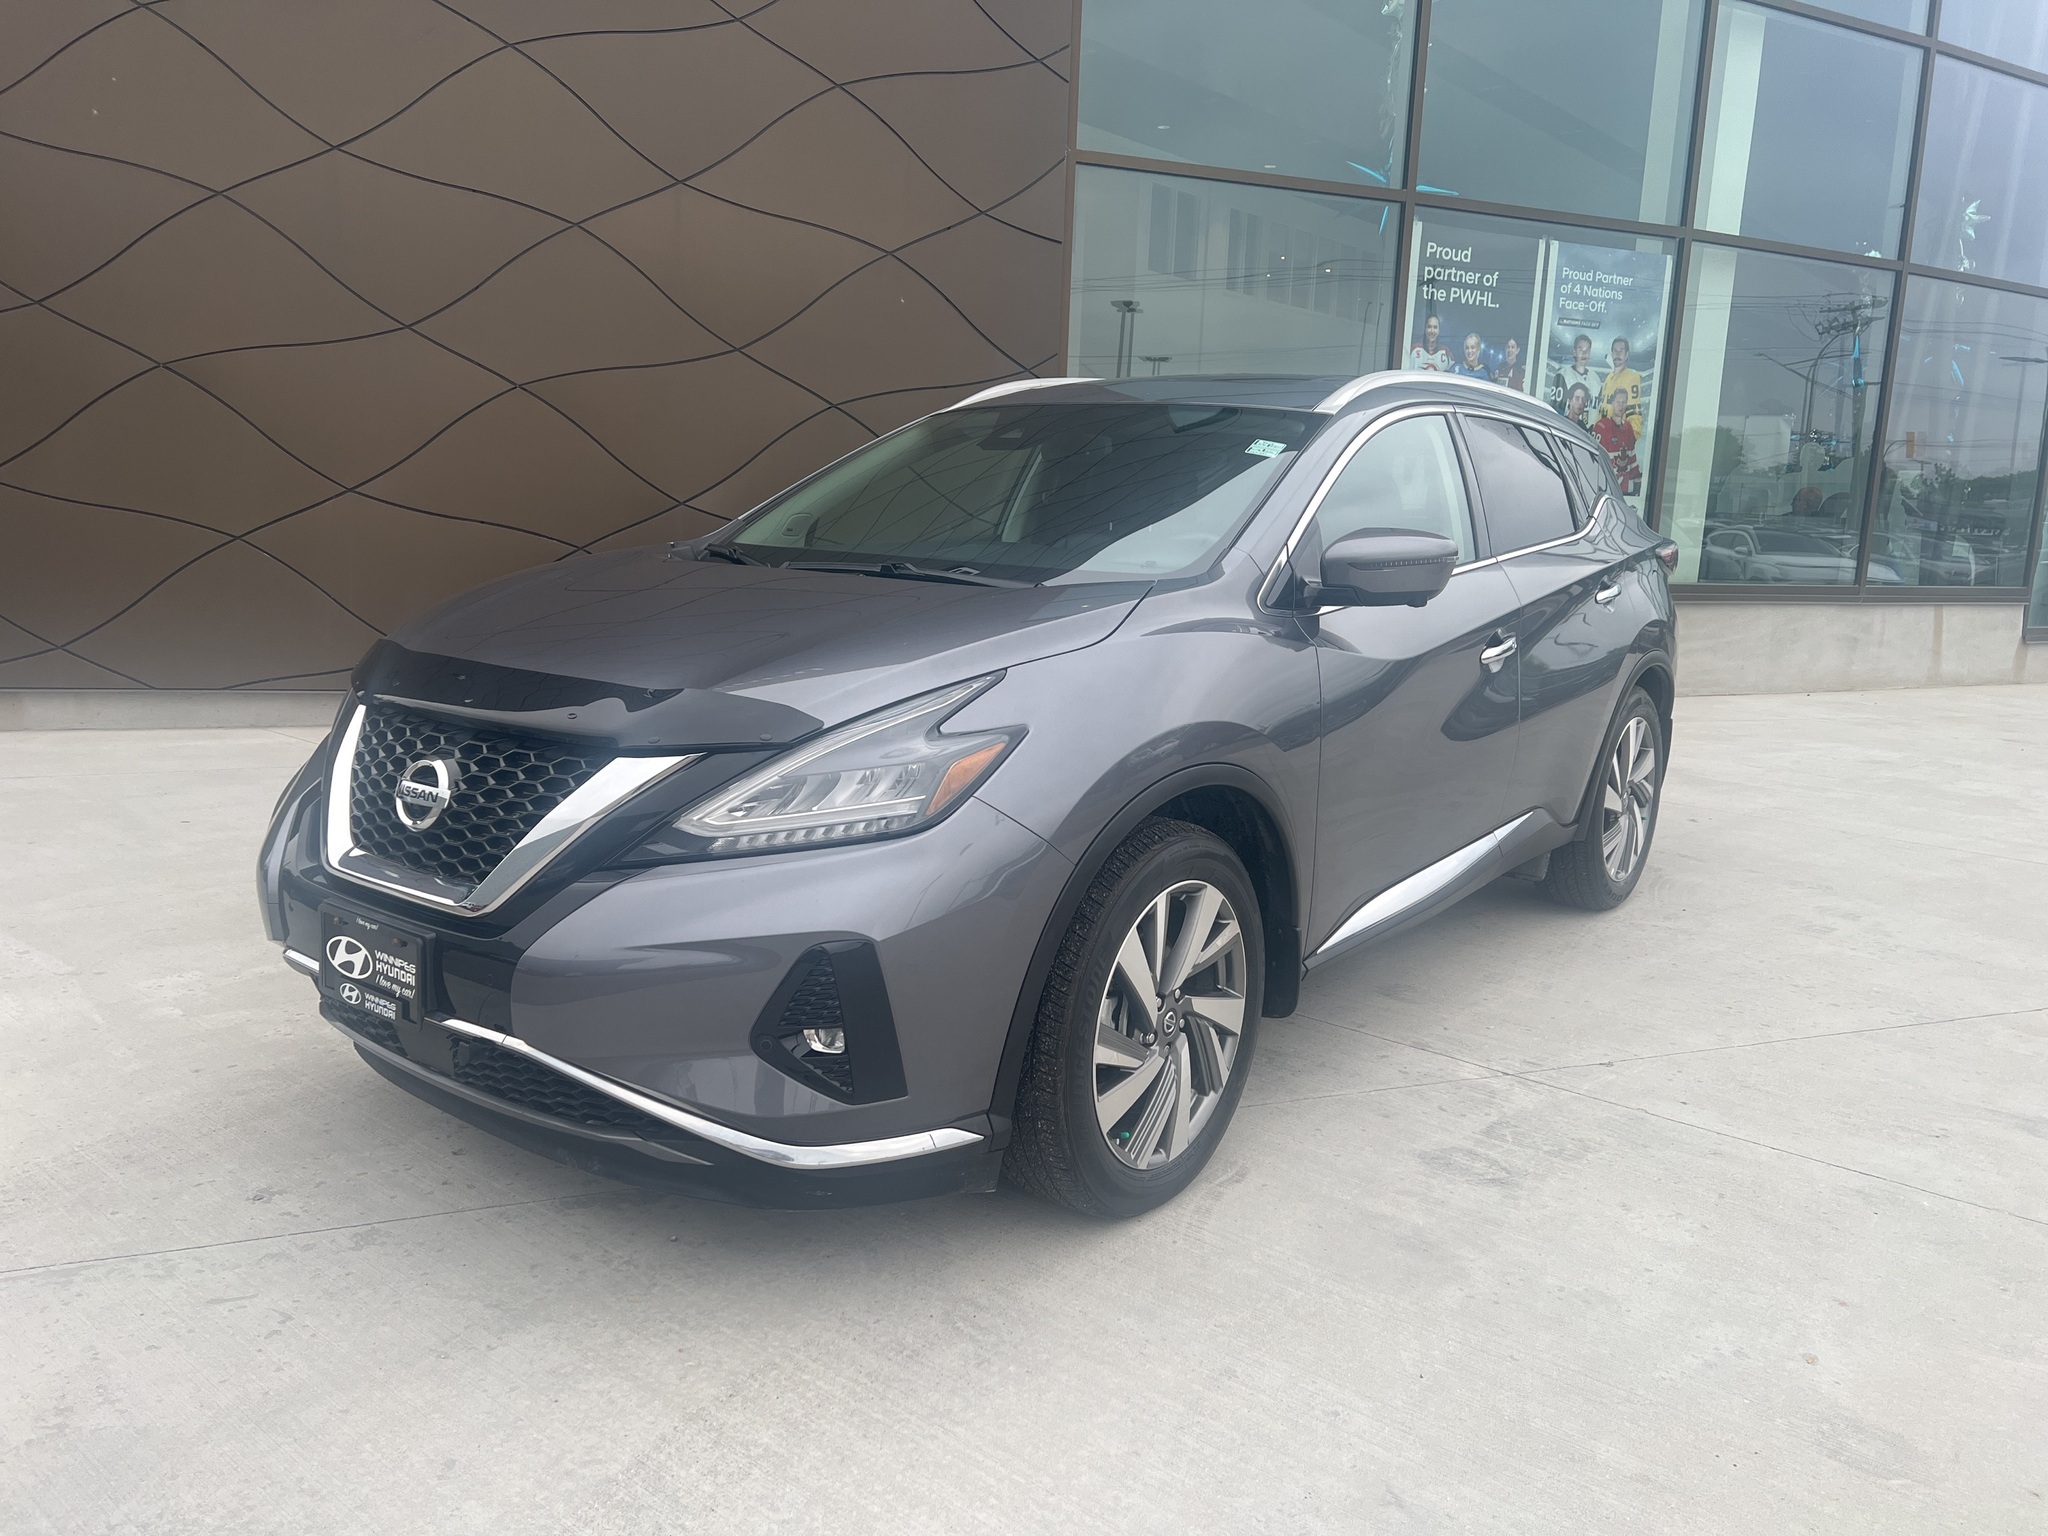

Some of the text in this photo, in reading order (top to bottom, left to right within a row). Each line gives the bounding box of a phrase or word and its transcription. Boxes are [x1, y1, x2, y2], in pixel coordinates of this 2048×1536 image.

[1426, 242, 1471, 263] Proud
[1424, 266, 1499, 287] partner of
[1562, 267, 1633, 286] Proud Partner
[1422, 284, 1499, 308] the PWHL.
[1560, 282, 1623, 300] of 4 Nations
[1559, 297, 1607, 313] Face-Off.
[1550, 386, 1564, 401] 20
[1631, 385, 1639, 399] 9
[375, 949, 416, 974] WINNIPEG
[375, 960, 416, 987] HYUNDAI
[364, 1000, 396, 1020] HYUNDAI
